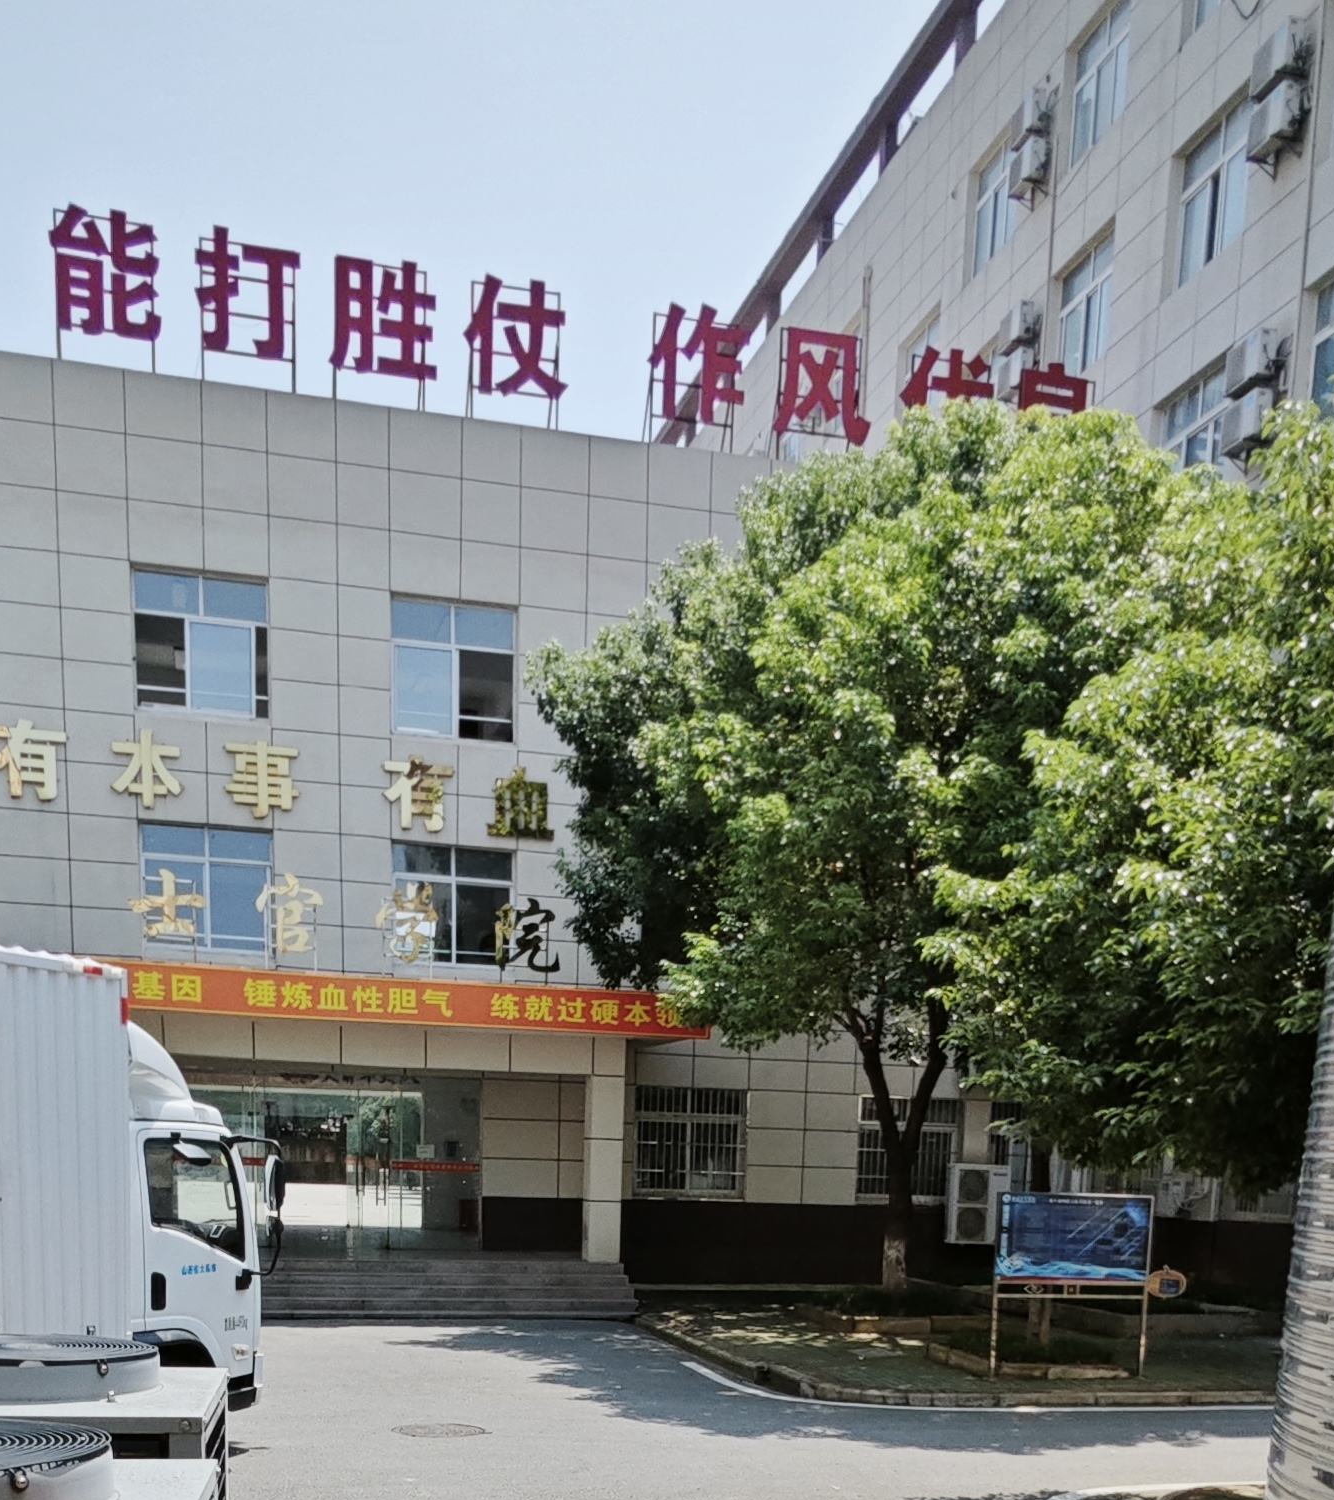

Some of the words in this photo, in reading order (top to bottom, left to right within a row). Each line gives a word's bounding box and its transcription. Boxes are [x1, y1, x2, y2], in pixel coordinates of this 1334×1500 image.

[47, 203, 567, 401] 能打胜仗
[128, 868, 560, 974] 士官学院
[132, 970, 203, 1003] 基因
[243, 977, 454, 1018] 锤炼血性胆气
